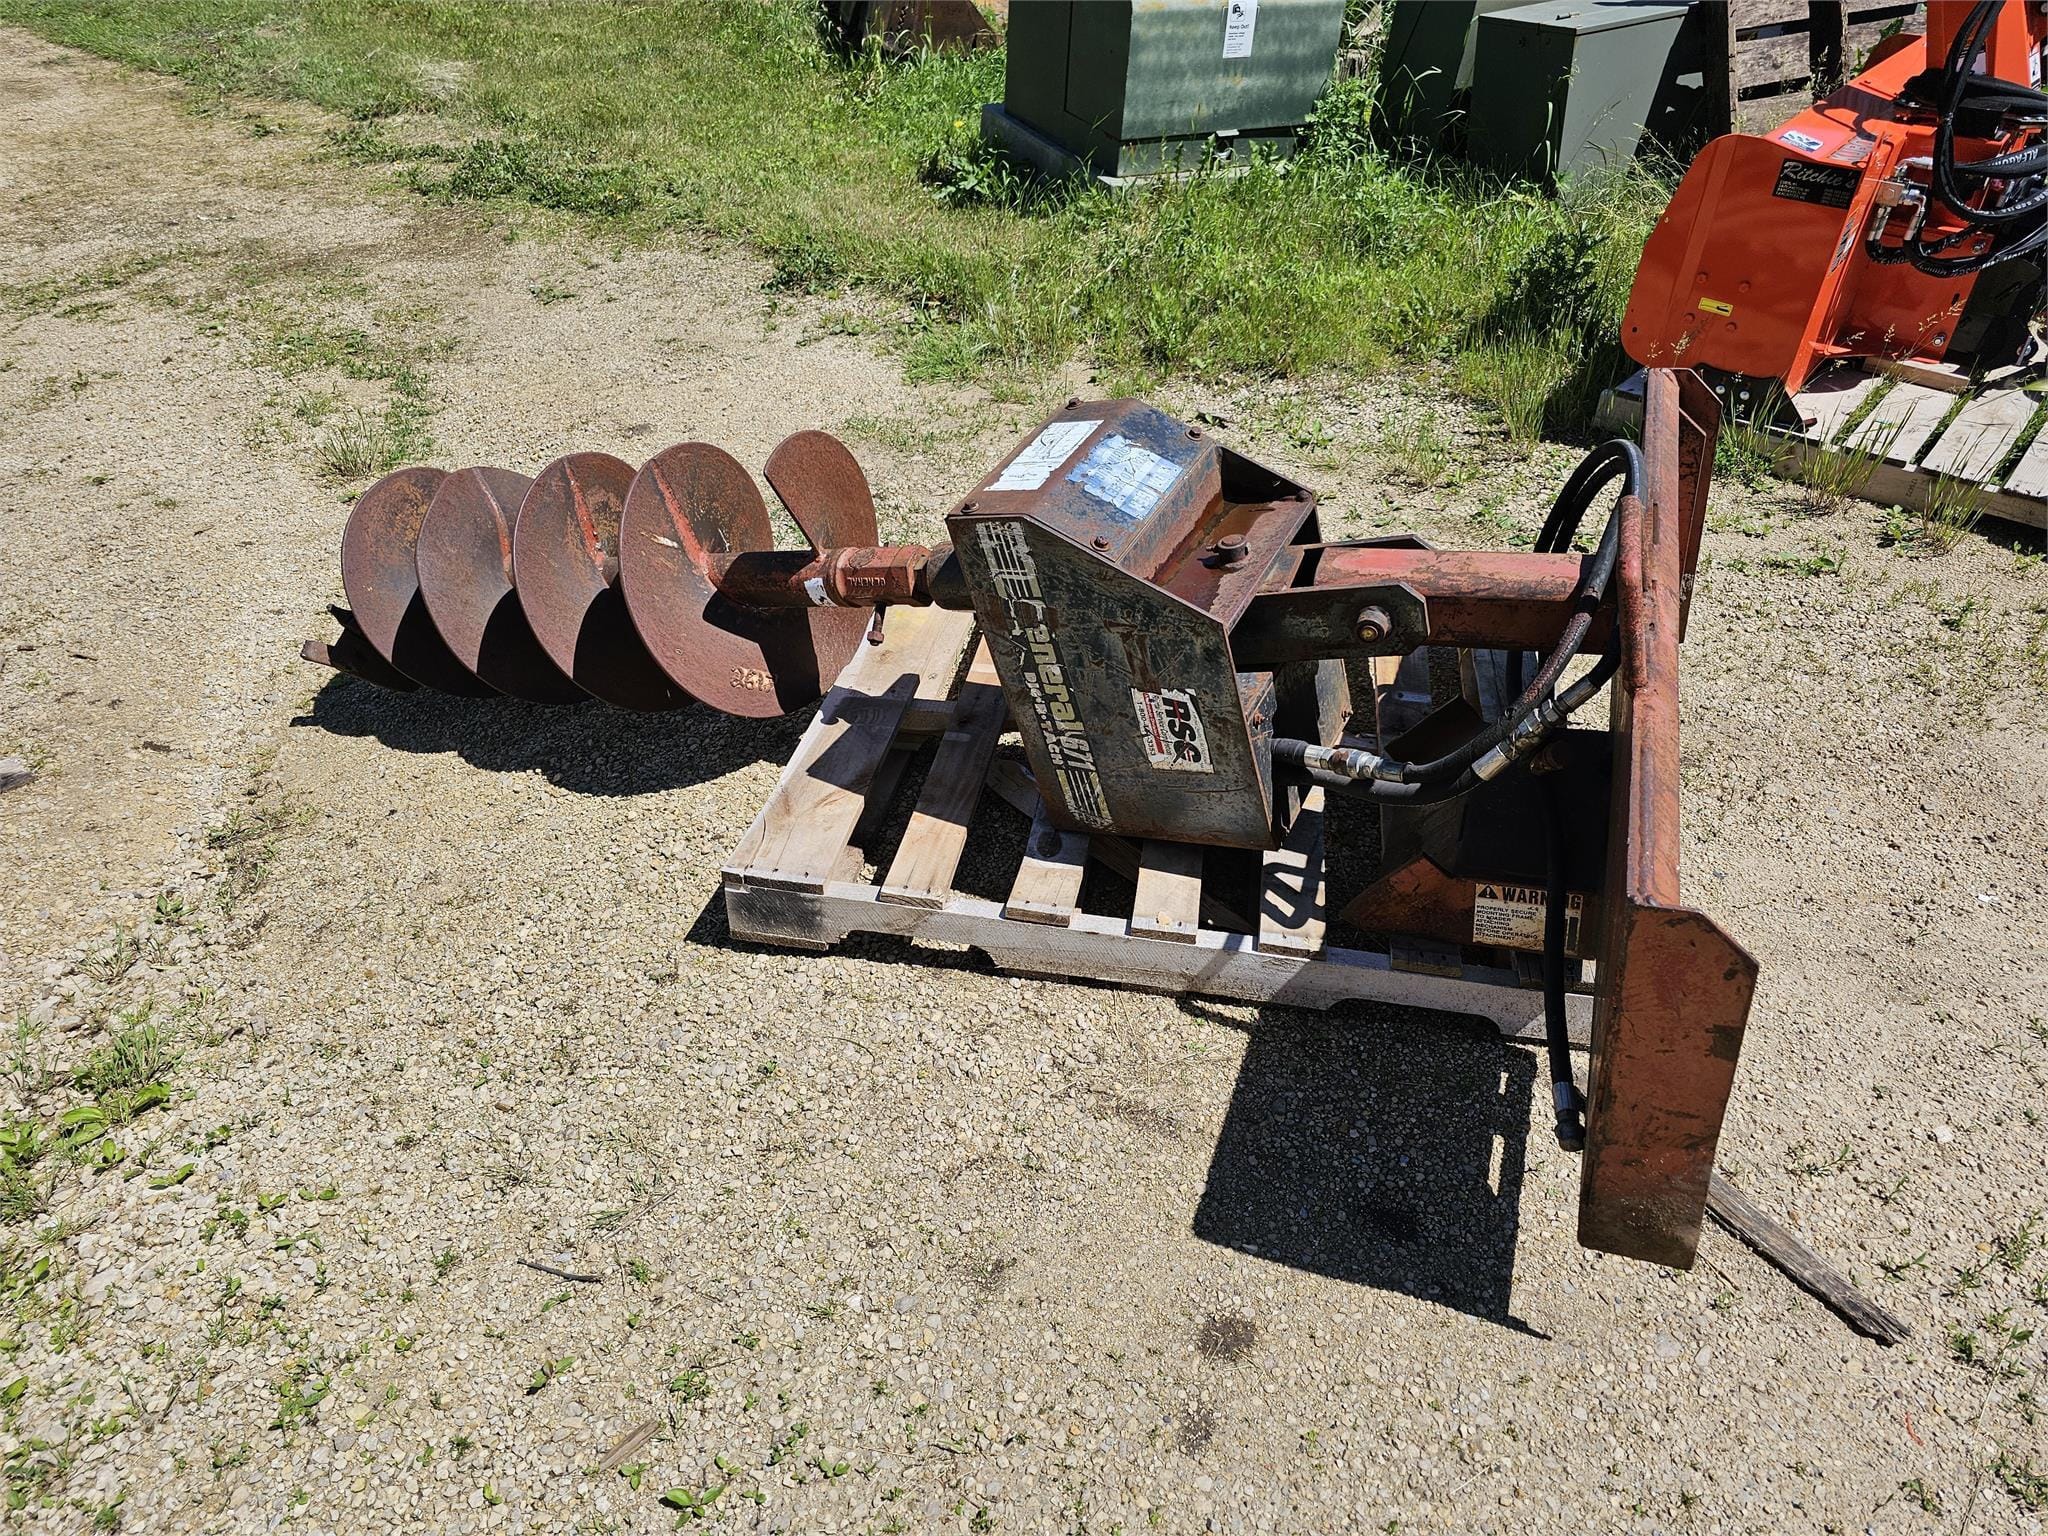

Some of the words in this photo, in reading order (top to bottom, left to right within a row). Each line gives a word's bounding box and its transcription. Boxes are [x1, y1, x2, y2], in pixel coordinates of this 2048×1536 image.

[1502, 886, 1582, 910] WARNG
[1476, 904, 1509, 913] PROPERLY
[1511, 908, 1537, 916] SECURE
[1475, 926, 1501, 935] BEFORE
